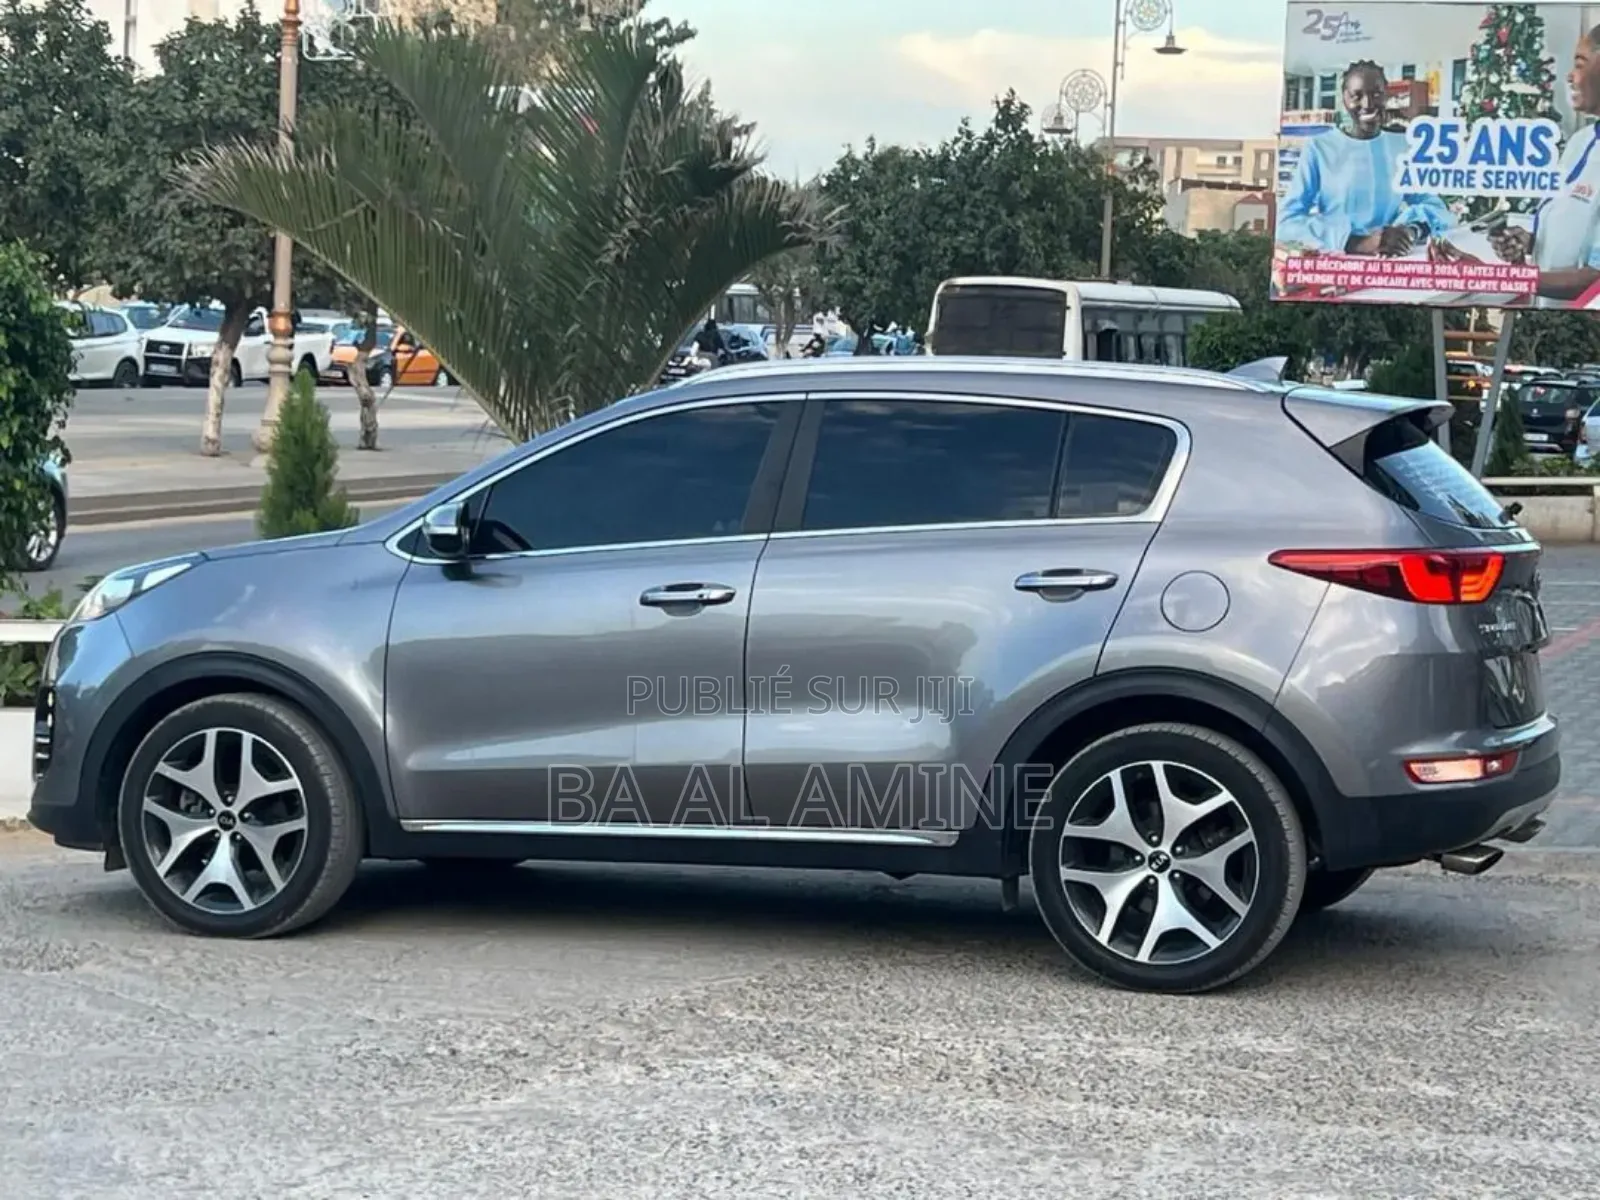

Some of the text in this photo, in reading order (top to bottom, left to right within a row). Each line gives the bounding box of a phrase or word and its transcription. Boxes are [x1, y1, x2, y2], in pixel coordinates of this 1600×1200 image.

[1302, 8, 1341, 41] 25
[1412, 122, 1554, 167] 25 ANS
[1400, 160, 1560, 191] À VOTRE SERVICE
[1288, 258, 1301, 270] DU
[1316, 257, 1365, 272] DÉCEMBRE
[1366, 261, 1380, 273] AU
[1394, 263, 1432, 275] JANVIER
[1463, 266, 1494, 277] FAITES
[1496, 267, 1507, 278] LE
[1510, 267, 1538, 279] PLEIN
[1337, 274, 1348, 285] ET
[1350, 275, 1362, 286] DE
[1364, 275, 1408, 287] CADEAUX
[1409, 276, 1433, 288] AVEC
[1435, 278, 1466, 290] VOTRE
[1467, 279, 1498, 291] CARTE
